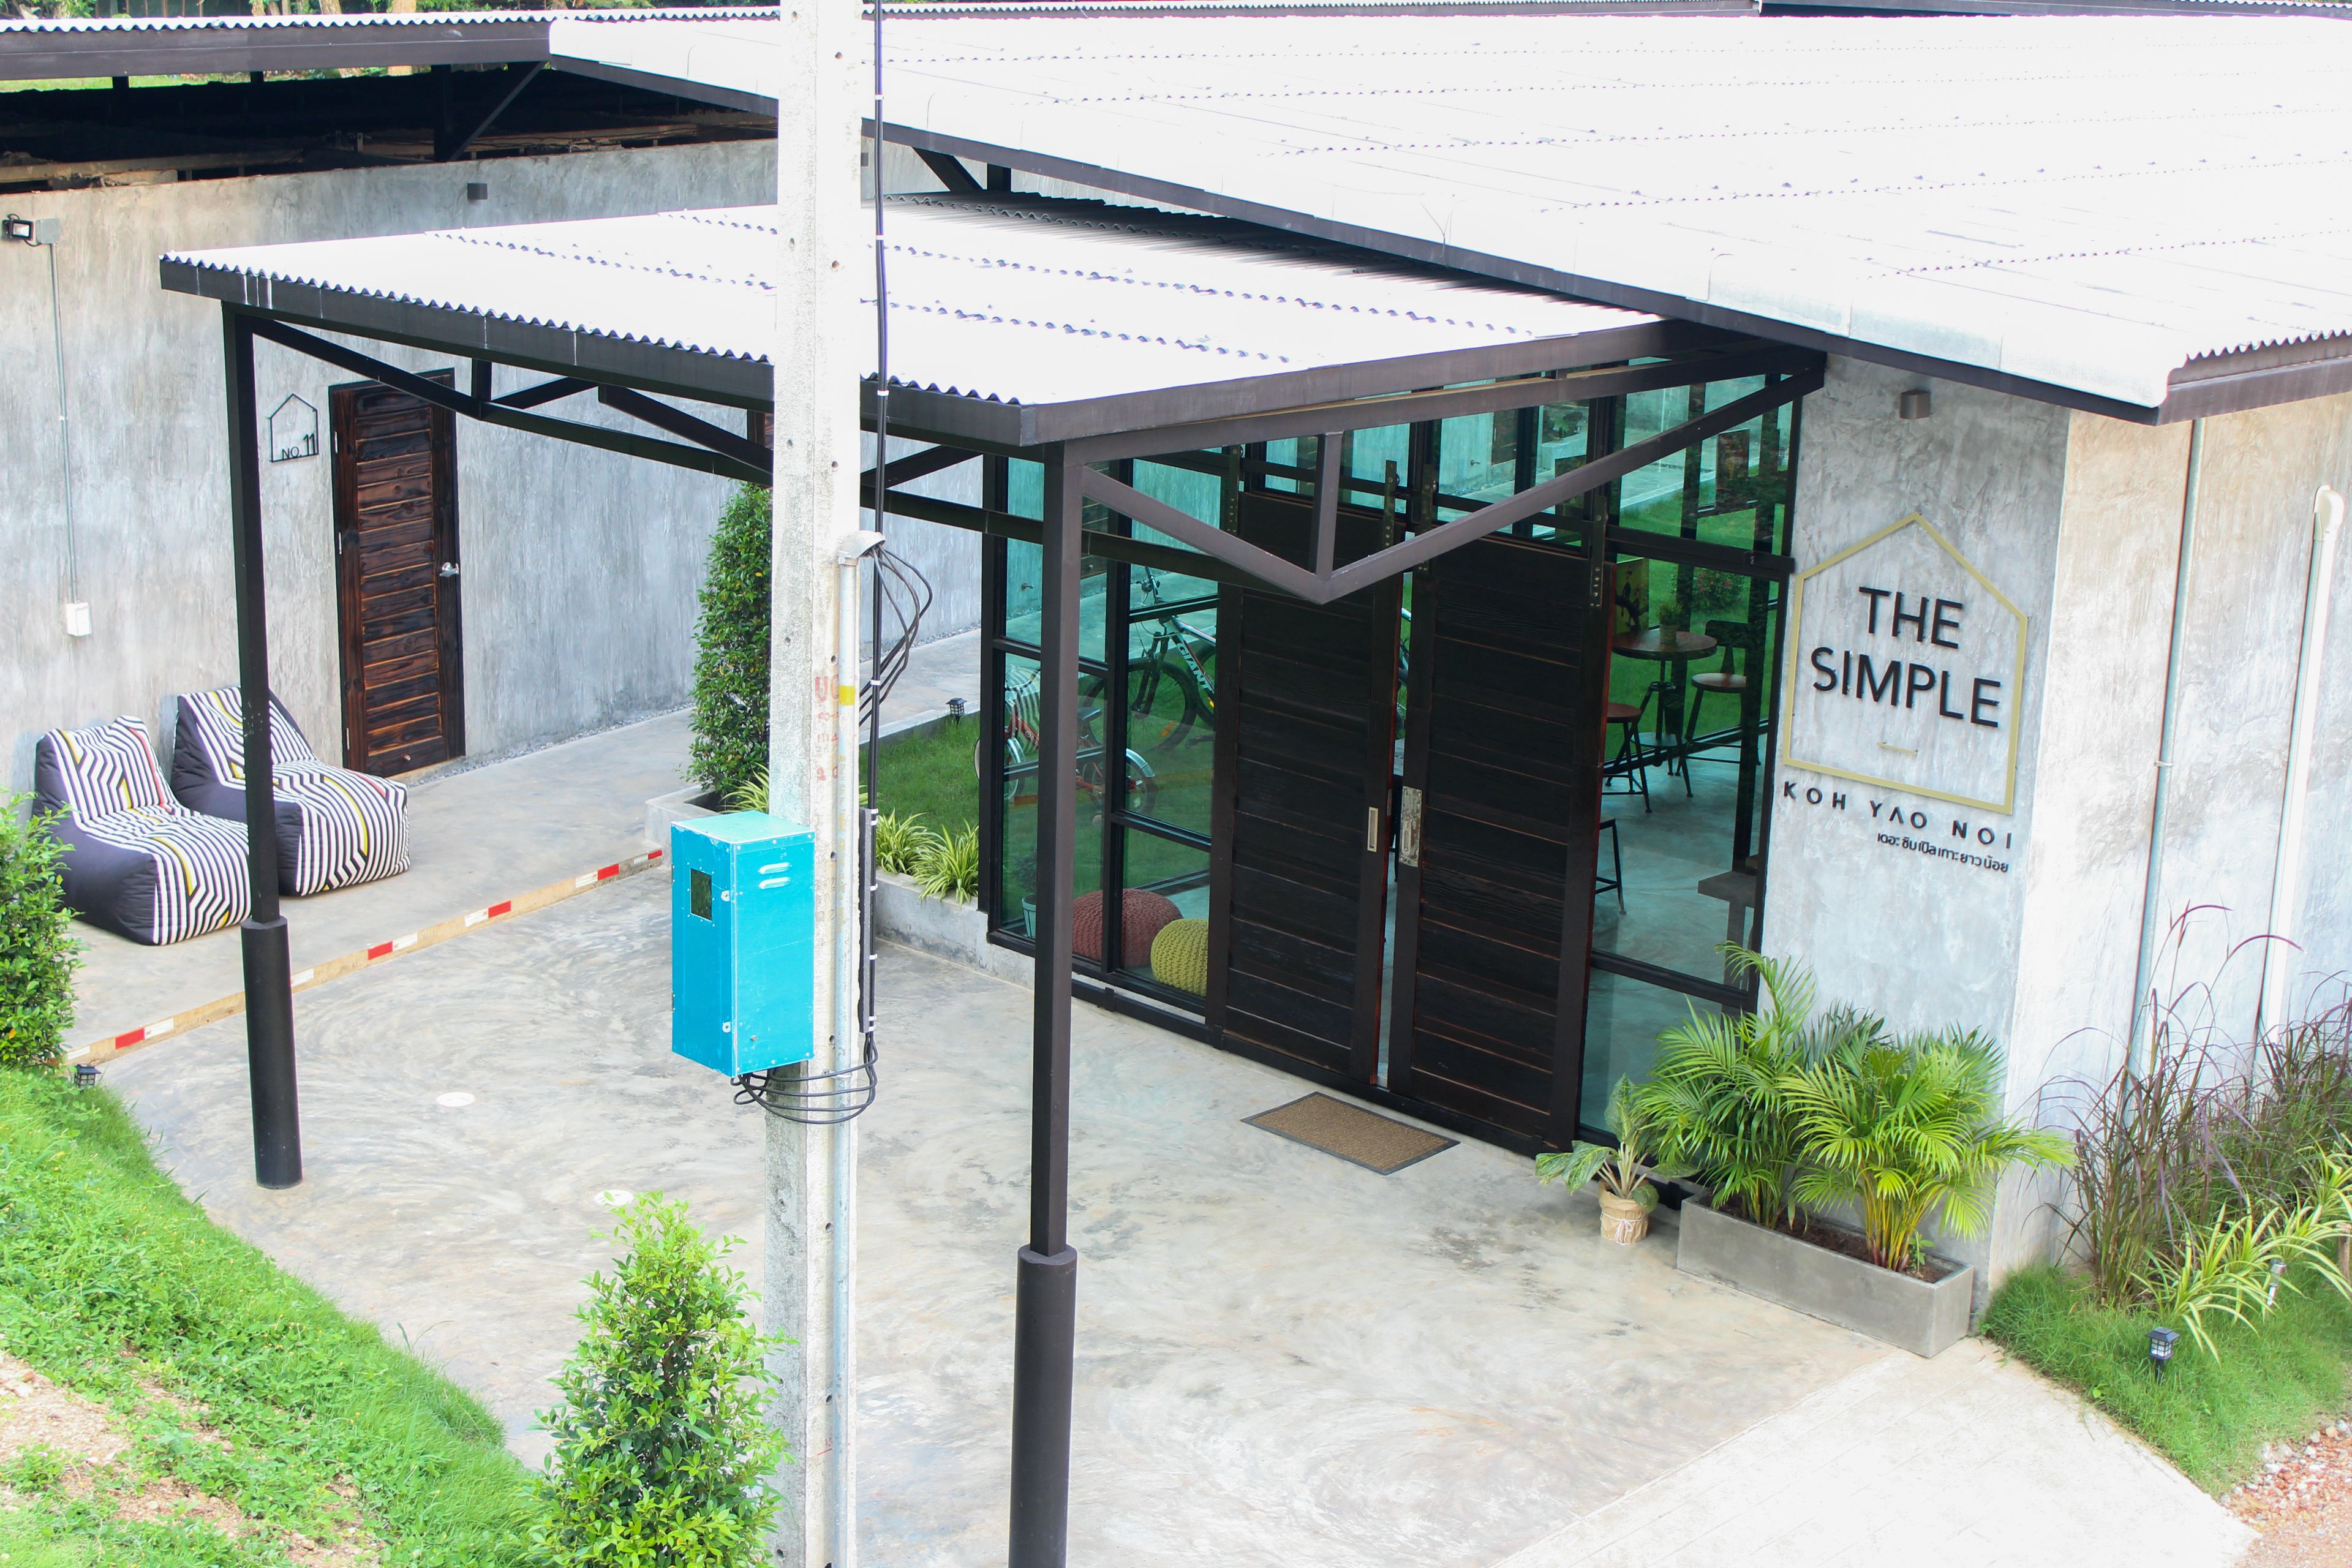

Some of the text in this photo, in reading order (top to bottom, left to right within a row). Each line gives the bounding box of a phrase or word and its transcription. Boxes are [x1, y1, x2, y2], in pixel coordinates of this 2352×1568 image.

[1858, 586, 1964, 649] THE
[1176, 643, 1215, 694] GIANT
[1811, 646, 2002, 728] SIMPLE
[1784, 780, 2012, 850] KOH YAO NOI
